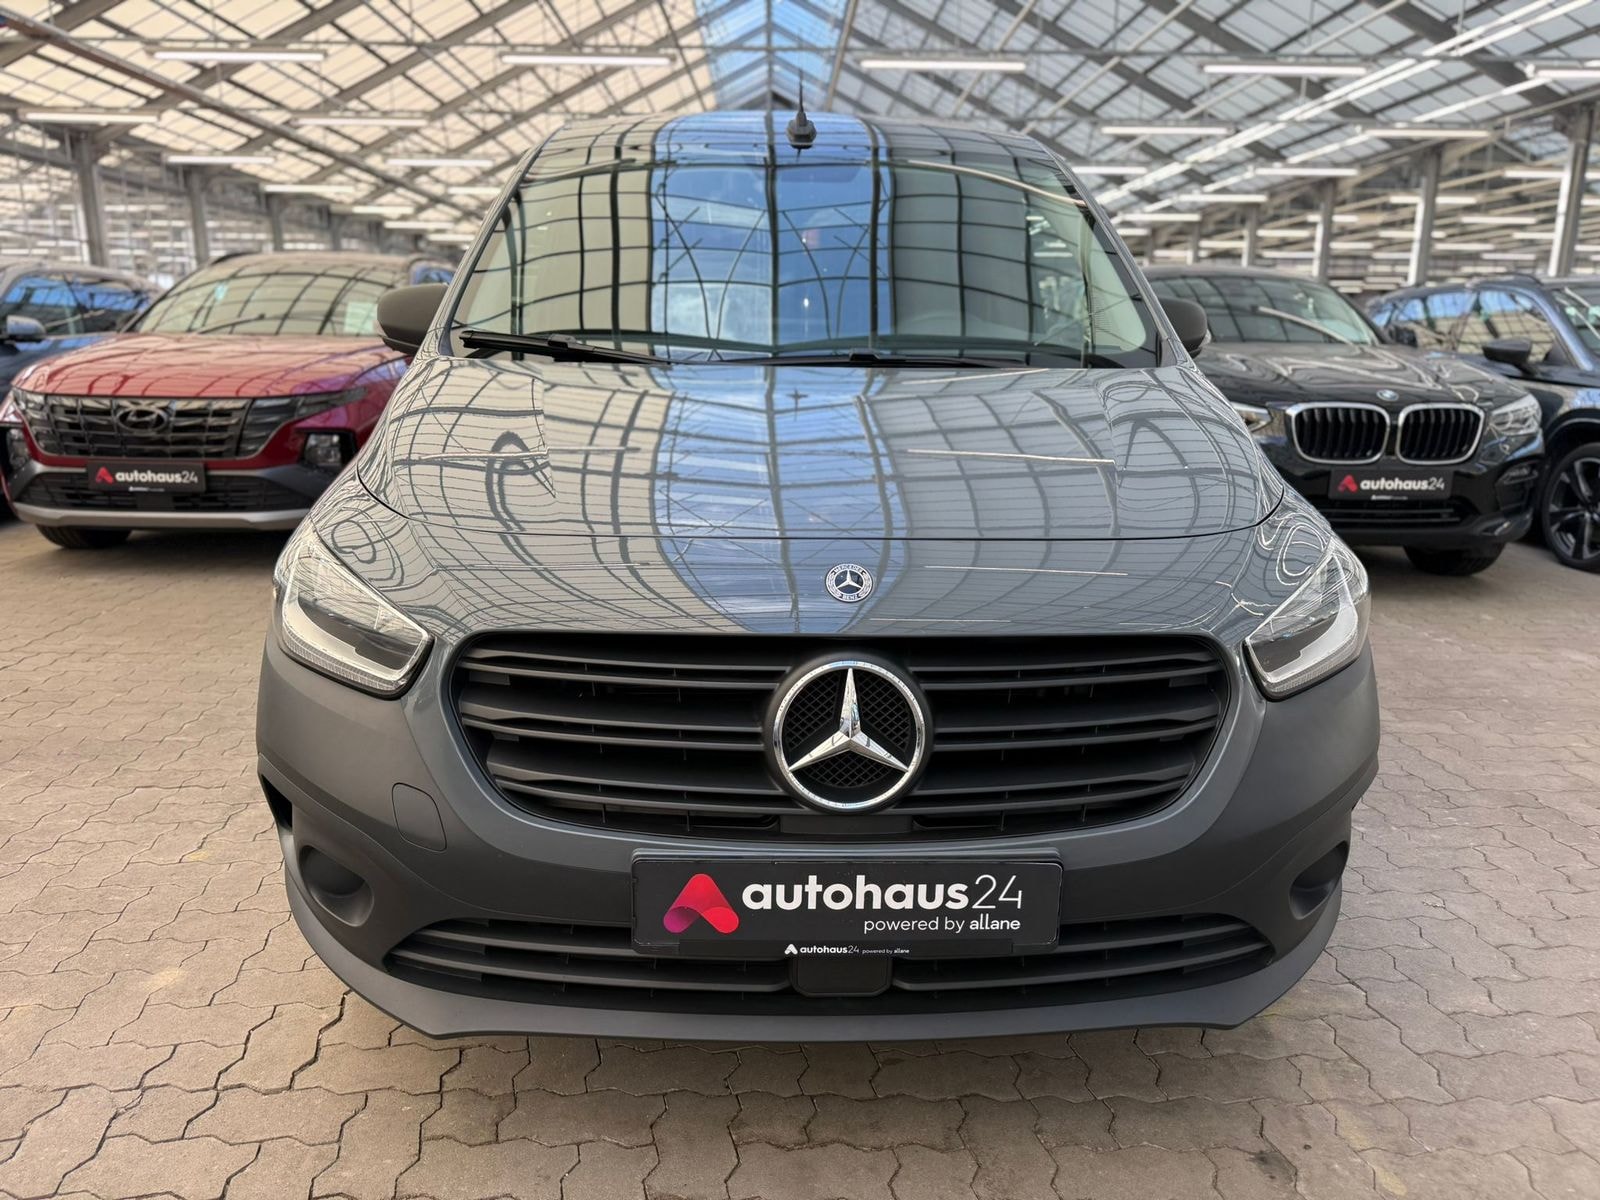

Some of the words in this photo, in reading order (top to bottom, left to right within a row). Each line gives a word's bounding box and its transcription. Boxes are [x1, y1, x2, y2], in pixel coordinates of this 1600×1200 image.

[115, 469, 198, 484] autohaus24
[1359, 477, 1445, 491] autohaus24
[741, 874, 1023, 911] autohaus24
[863, 914, 939, 935] powered
[944, 914, 966, 935] by
[969, 914, 1021, 932] allane
[799, 945, 860, 954] autohaus24
[886, 947, 893, 955] by
